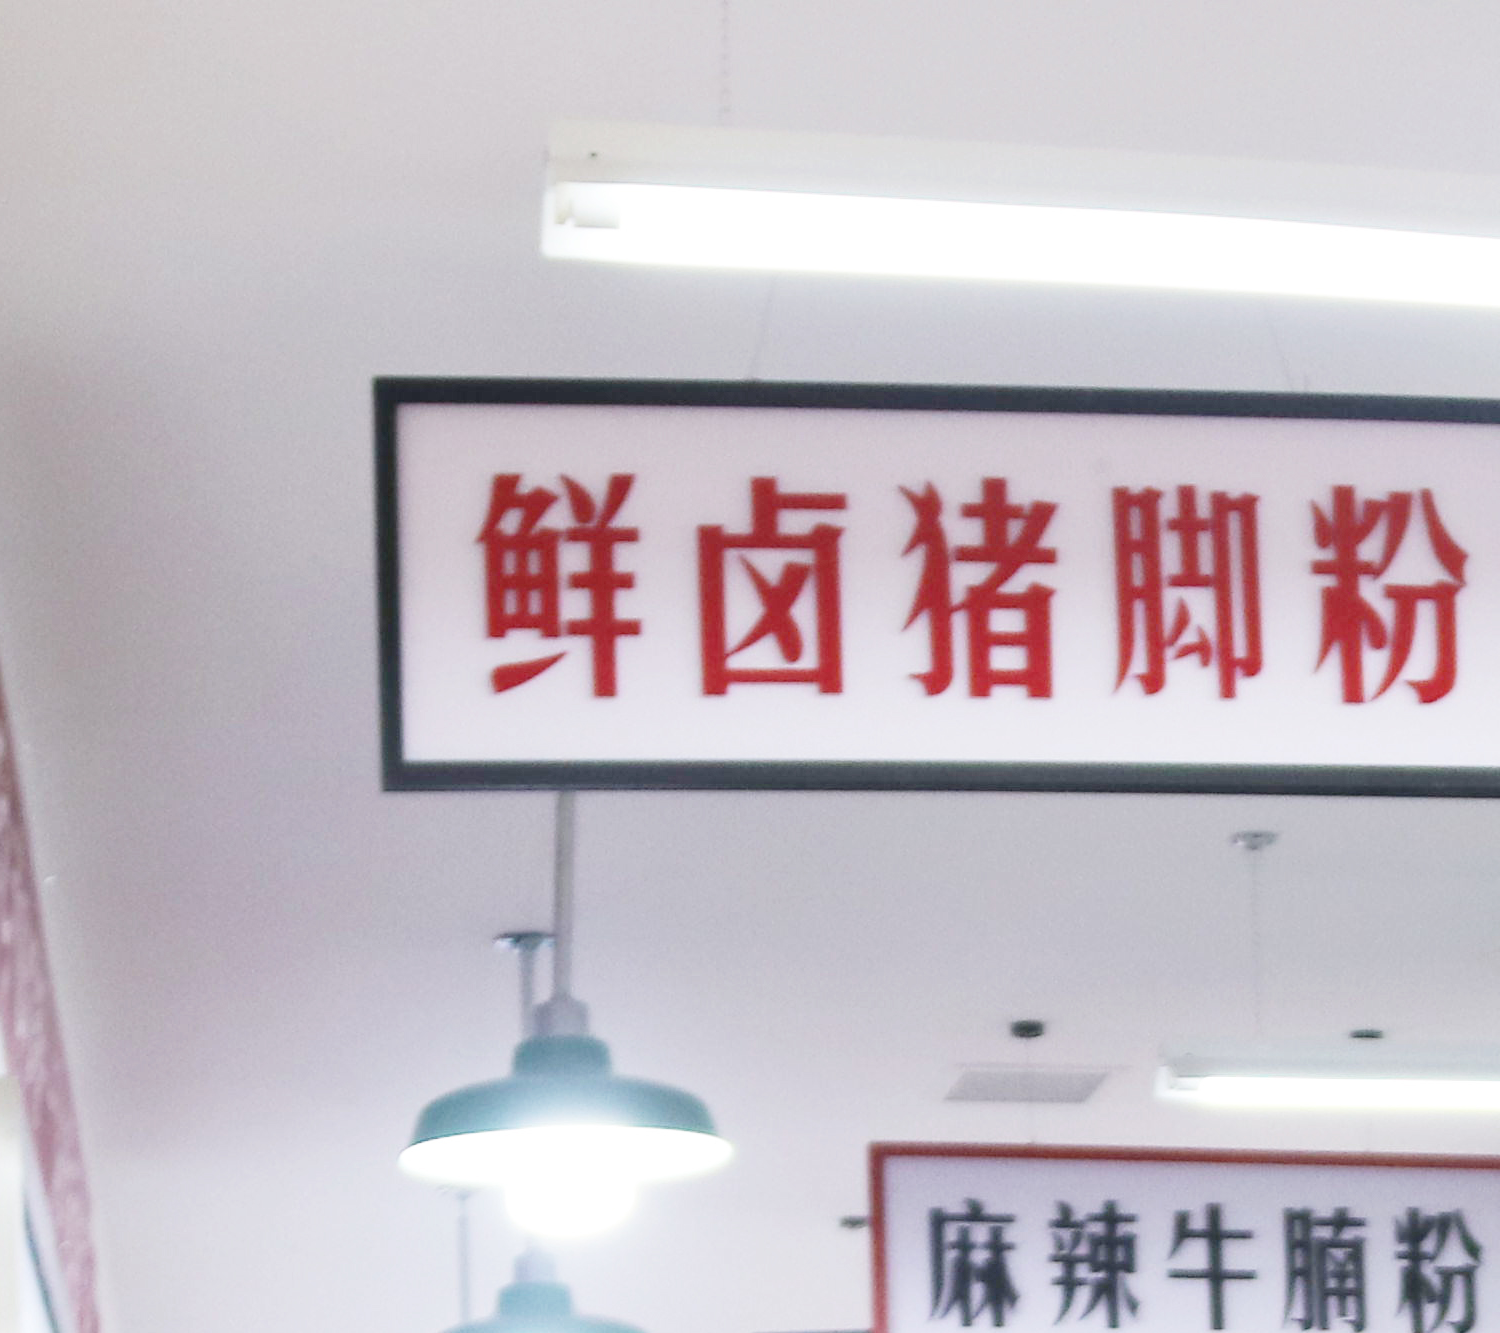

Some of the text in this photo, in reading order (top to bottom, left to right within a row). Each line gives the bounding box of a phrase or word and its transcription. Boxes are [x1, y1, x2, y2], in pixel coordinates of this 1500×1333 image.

[476, 471, 1470, 707] 鲜卤猪脚粉
